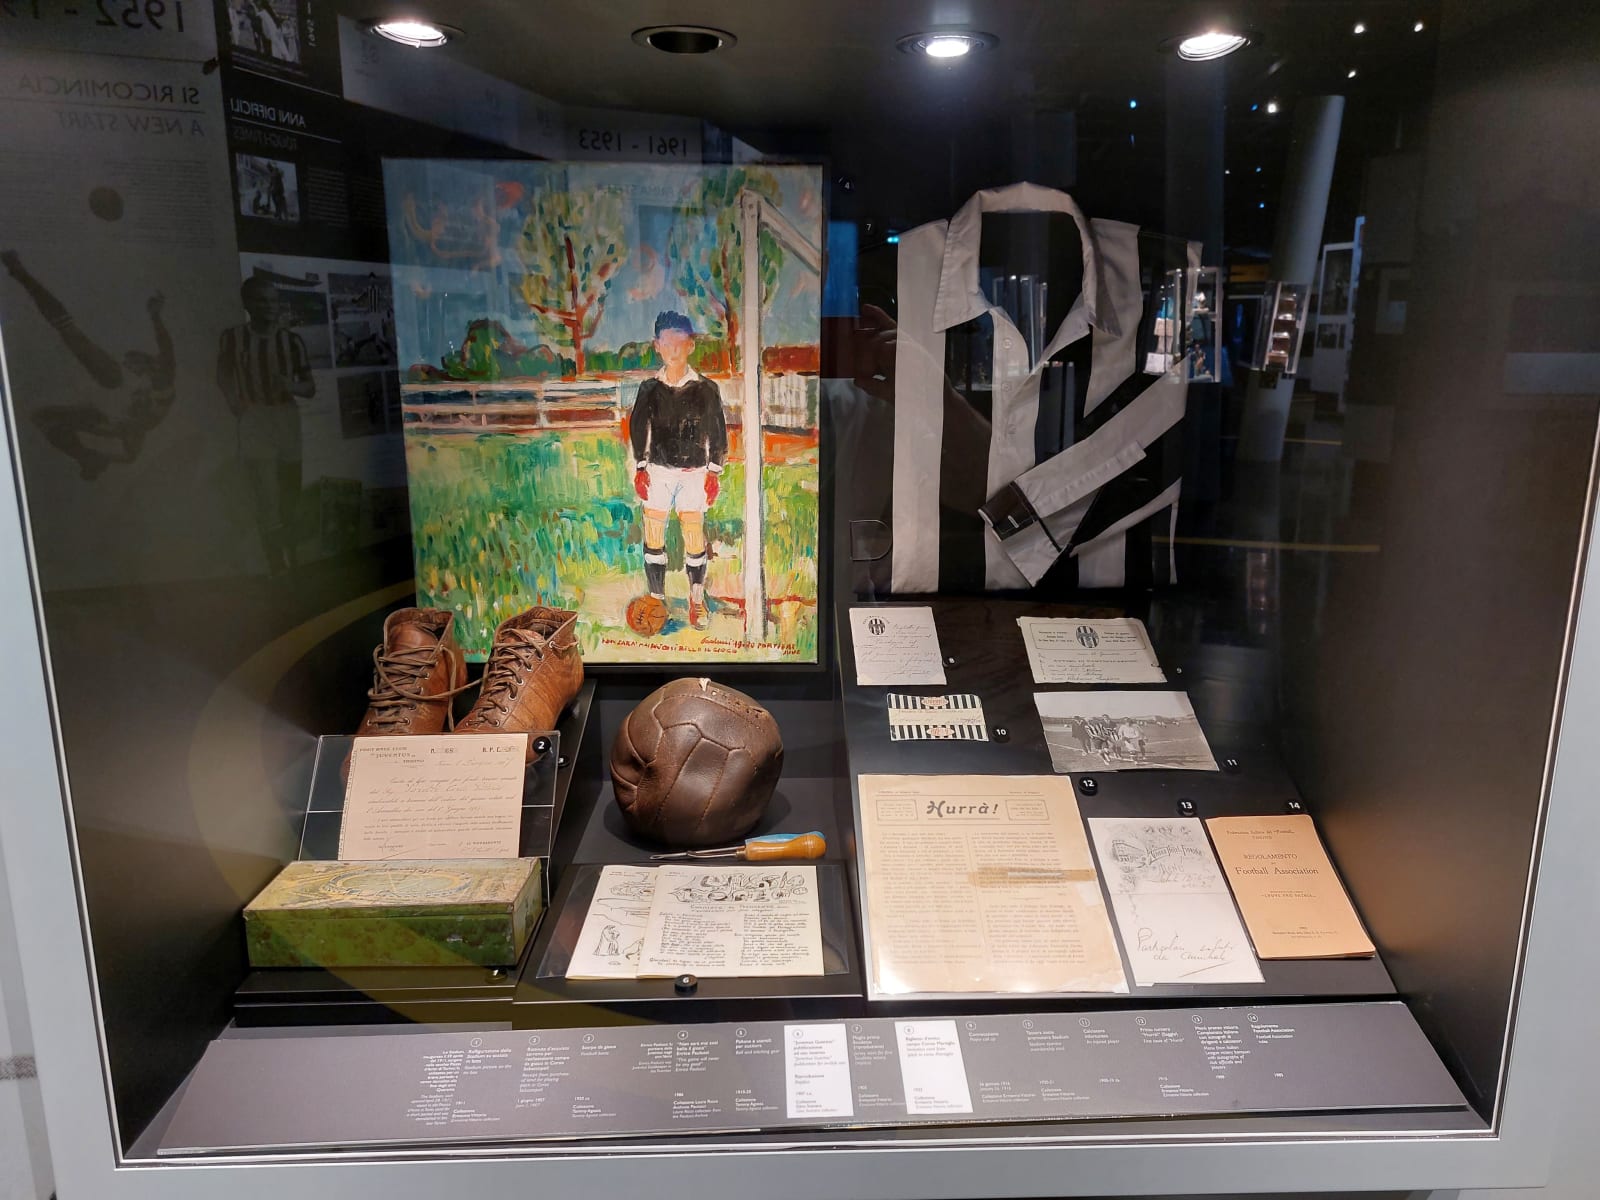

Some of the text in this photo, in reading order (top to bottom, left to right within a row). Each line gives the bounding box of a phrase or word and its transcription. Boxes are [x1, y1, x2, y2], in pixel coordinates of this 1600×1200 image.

[995, 728, 1007, 736] 10
[538, 741, 546, 750] 2
[1082, 779, 1095, 788] 12
[926, 800, 999, 818] Hurrà!
[1181, 801, 1193, 810] 13
[1288, 801, 1301, 810] 14
[1235, 866, 1319, 875] Football Association
